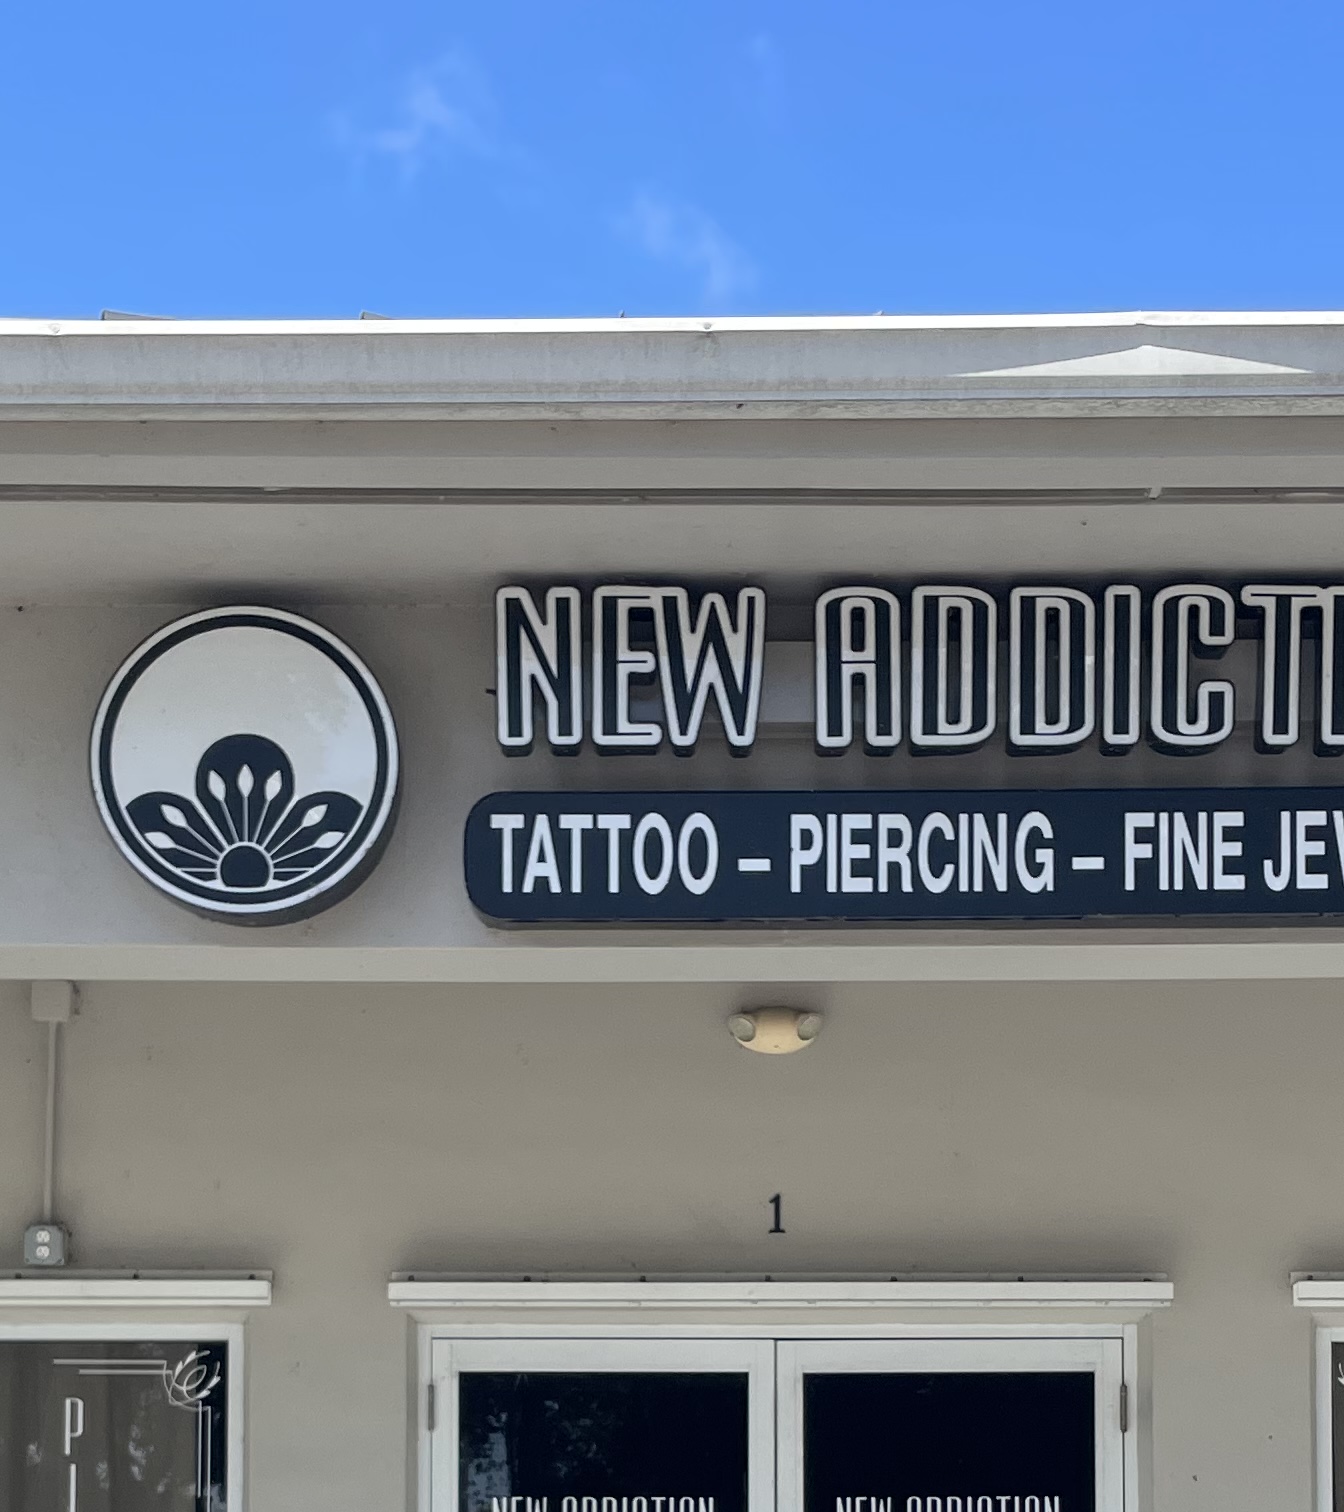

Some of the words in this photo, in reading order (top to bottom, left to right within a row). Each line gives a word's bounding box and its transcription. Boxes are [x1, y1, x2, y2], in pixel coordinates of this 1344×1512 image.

[495, 584, 767, 747] NEW
[490, 812, 719, 895] TATTOO
[790, 810, 1055, 895] PIERCING
[1124, 810, 1246, 893] FINE
[768, 1193, 786, 1233] 1
